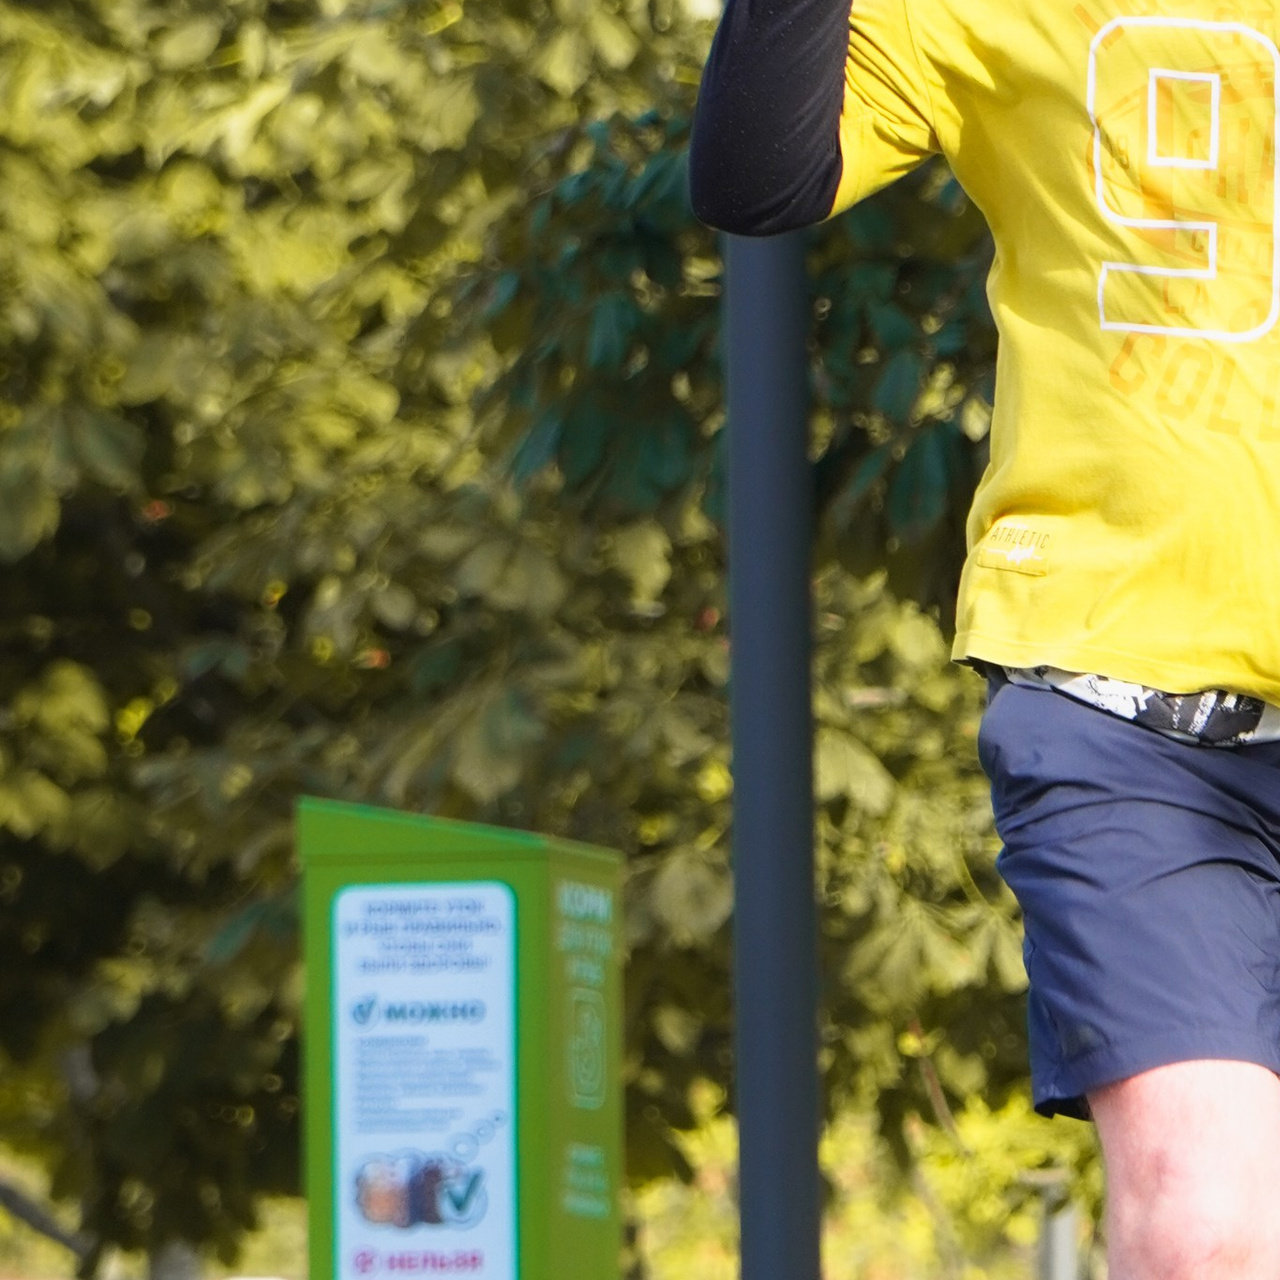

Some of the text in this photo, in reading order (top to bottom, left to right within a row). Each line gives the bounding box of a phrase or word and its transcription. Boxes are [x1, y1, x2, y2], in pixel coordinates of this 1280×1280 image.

[990, 527, 1049, 549] ATHLETIC
[384, 1000, 484, 1021] МОЖНО
[386, 1253, 483, 1271] НЕЛЬЗЯ
